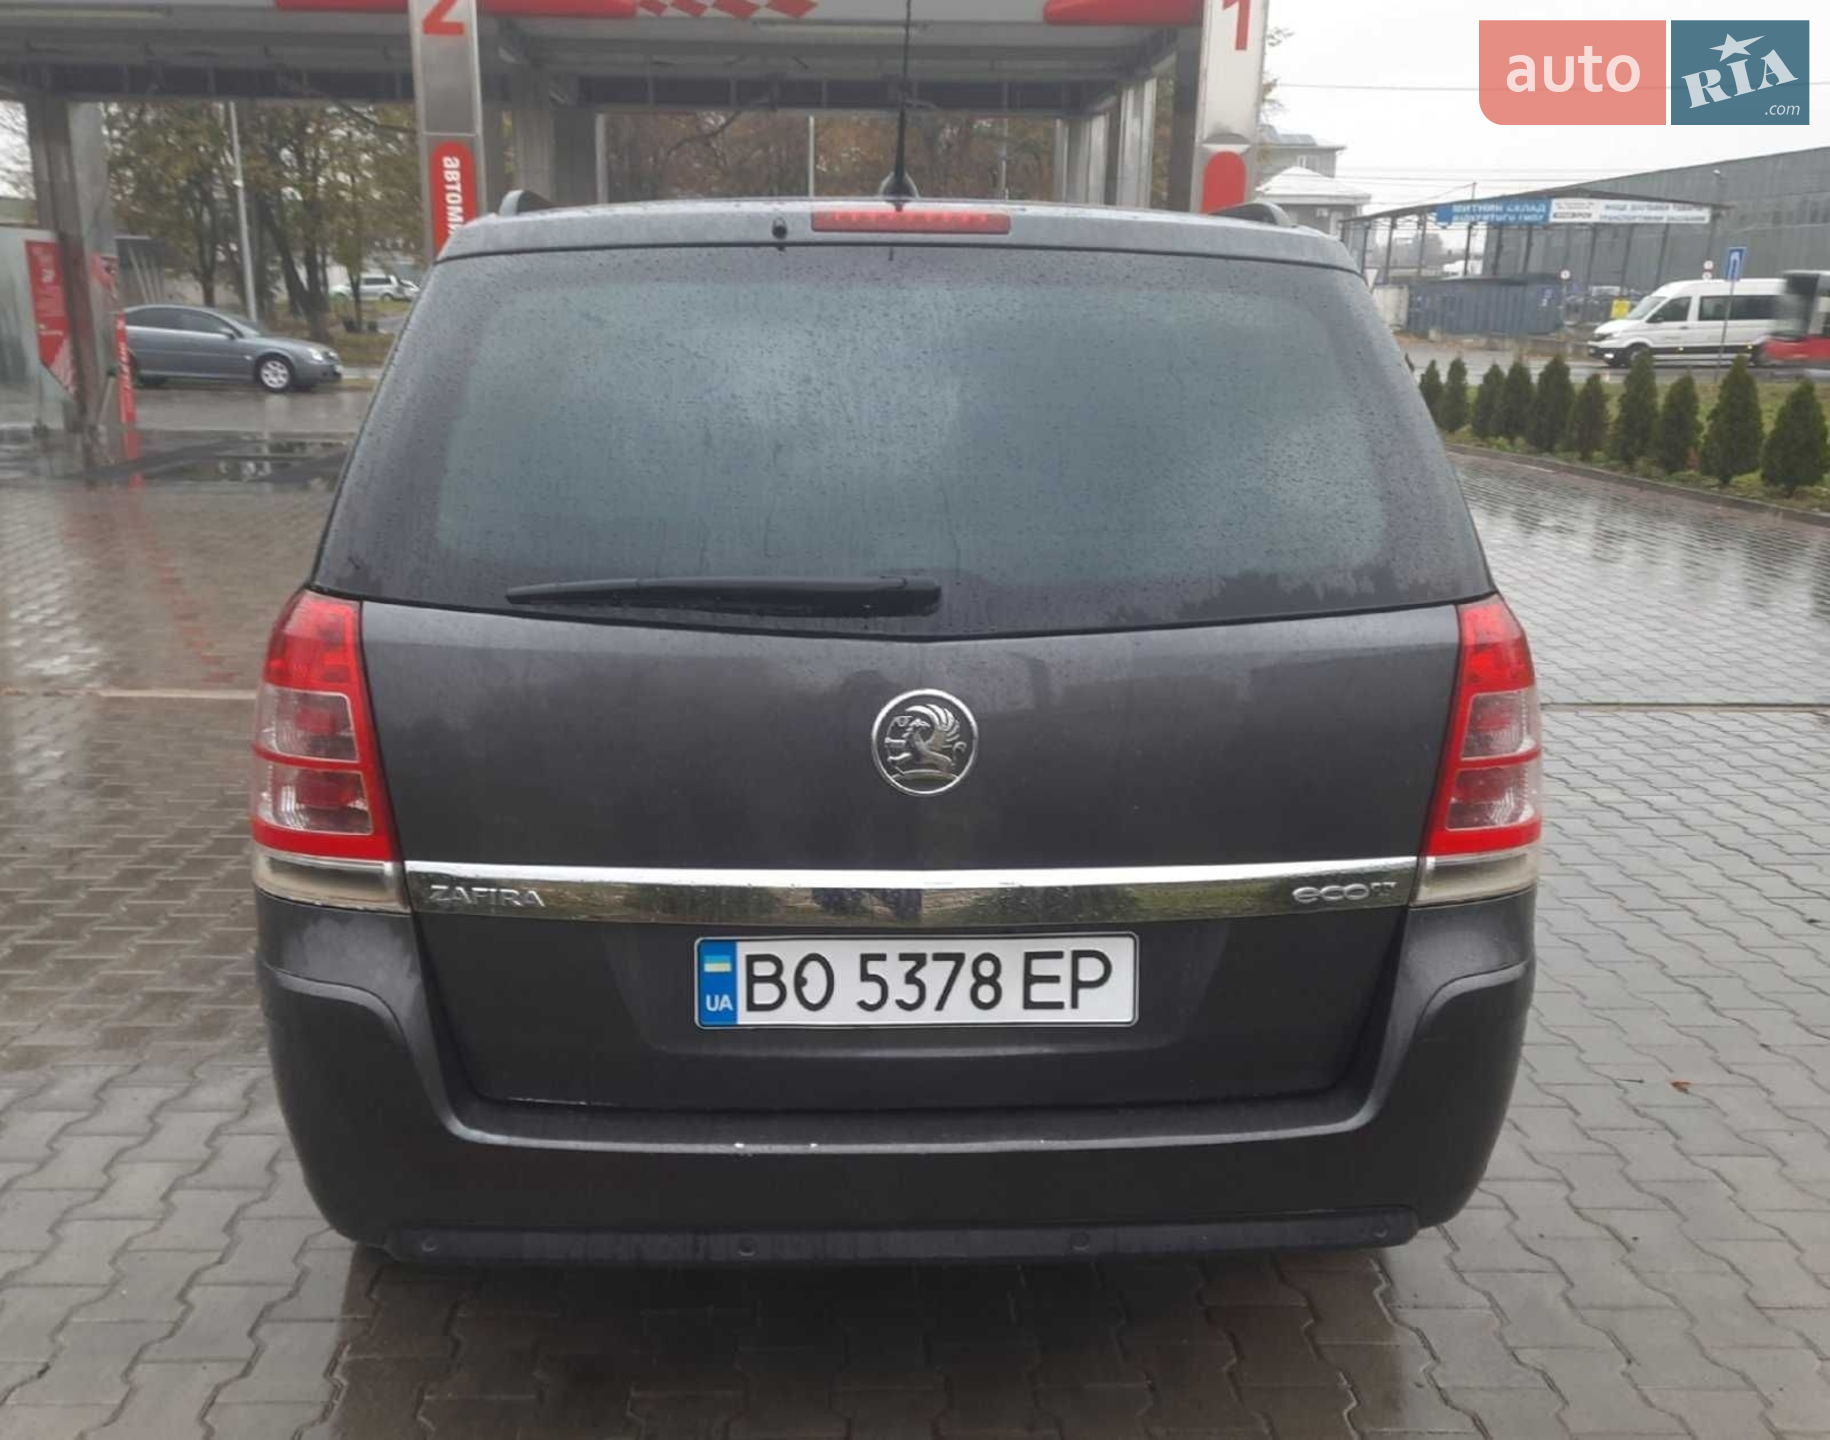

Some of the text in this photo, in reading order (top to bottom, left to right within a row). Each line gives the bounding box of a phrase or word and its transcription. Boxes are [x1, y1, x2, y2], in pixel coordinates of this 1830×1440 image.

[423, 0, 465, 35] 2
[1222, 0, 1251, 51] 1
[430, 884, 545, 907] ZAFIRA
[745, 949, 1112, 1012] BO 5378 EP
[706, 995, 733, 1012] UA
